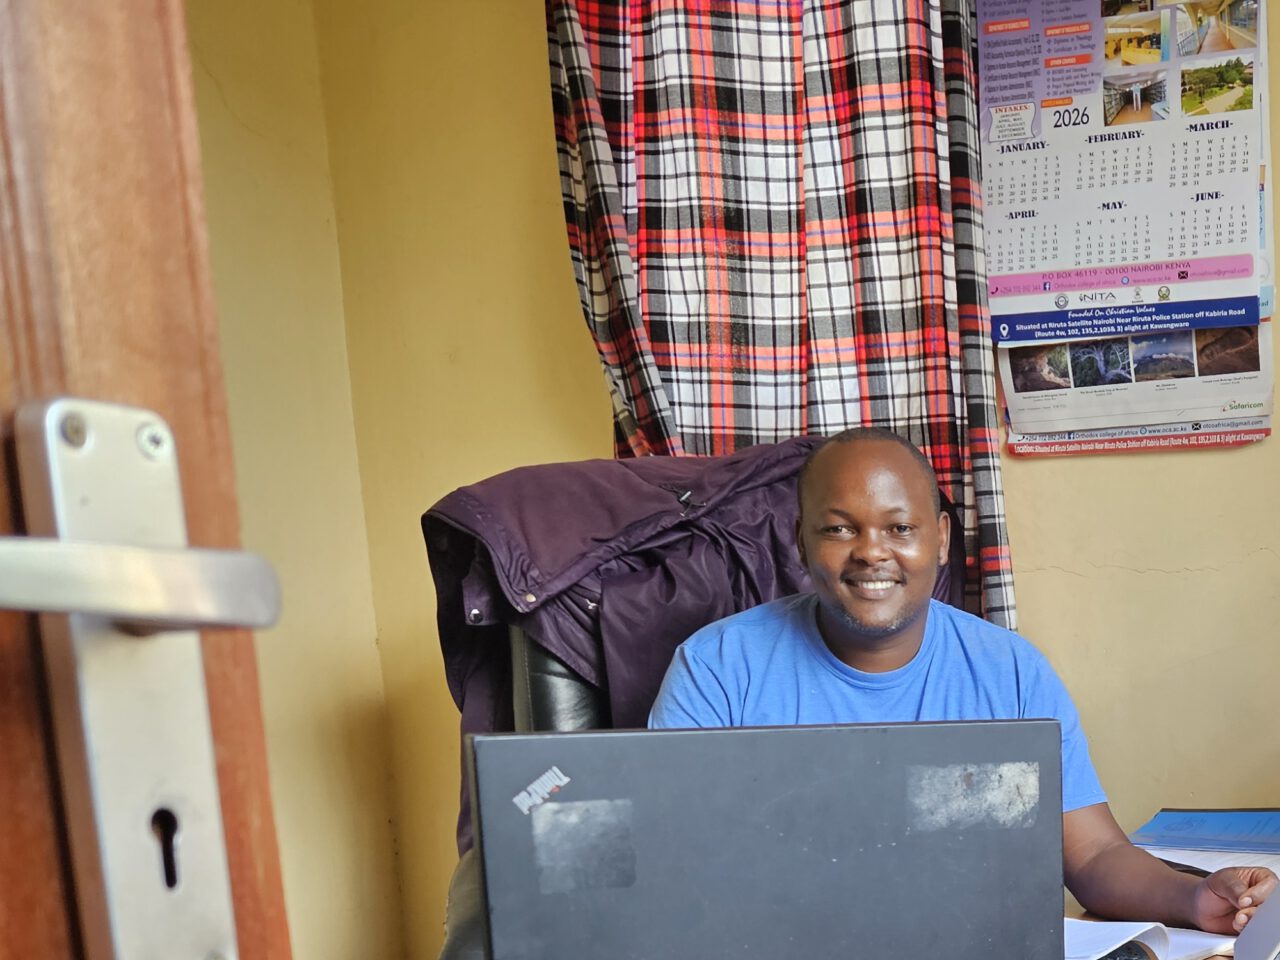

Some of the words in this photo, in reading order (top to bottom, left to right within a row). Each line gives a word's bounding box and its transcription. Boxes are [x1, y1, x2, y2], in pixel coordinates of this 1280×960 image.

[1053, 106, 1090, 128] 2026
[1057, 271, 1072, 279] BOX
[1075, 269, 1097, 277] 46119
[1105, 266, 1128, 275] 00100
[1131, 263, 1163, 273] NAIROBI
[1165, 262, 1191, 270] KENYA
[1016, 323, 1040, 331] Situated
[1152, 313, 1170, 321] Police
[1172, 312, 1194, 320] Station
[1205, 309, 1227, 317] Kabiria
[1068, 310, 1093, 319] Founded
[1106, 307, 1134, 316] Christian
[1136, 305, 1155, 313] Values
[1035, 330, 1055, 338] (Route
[1068, 328, 1080, 336] 102,
[1124, 323, 1141, 333] alight
[1150, 321, 1189, 331] Kawangware
[1229, 402, 1264, 411] Safaricom
[1099, 431, 1117, 439] college
[512, 765, 571, 815] ThinkPad
